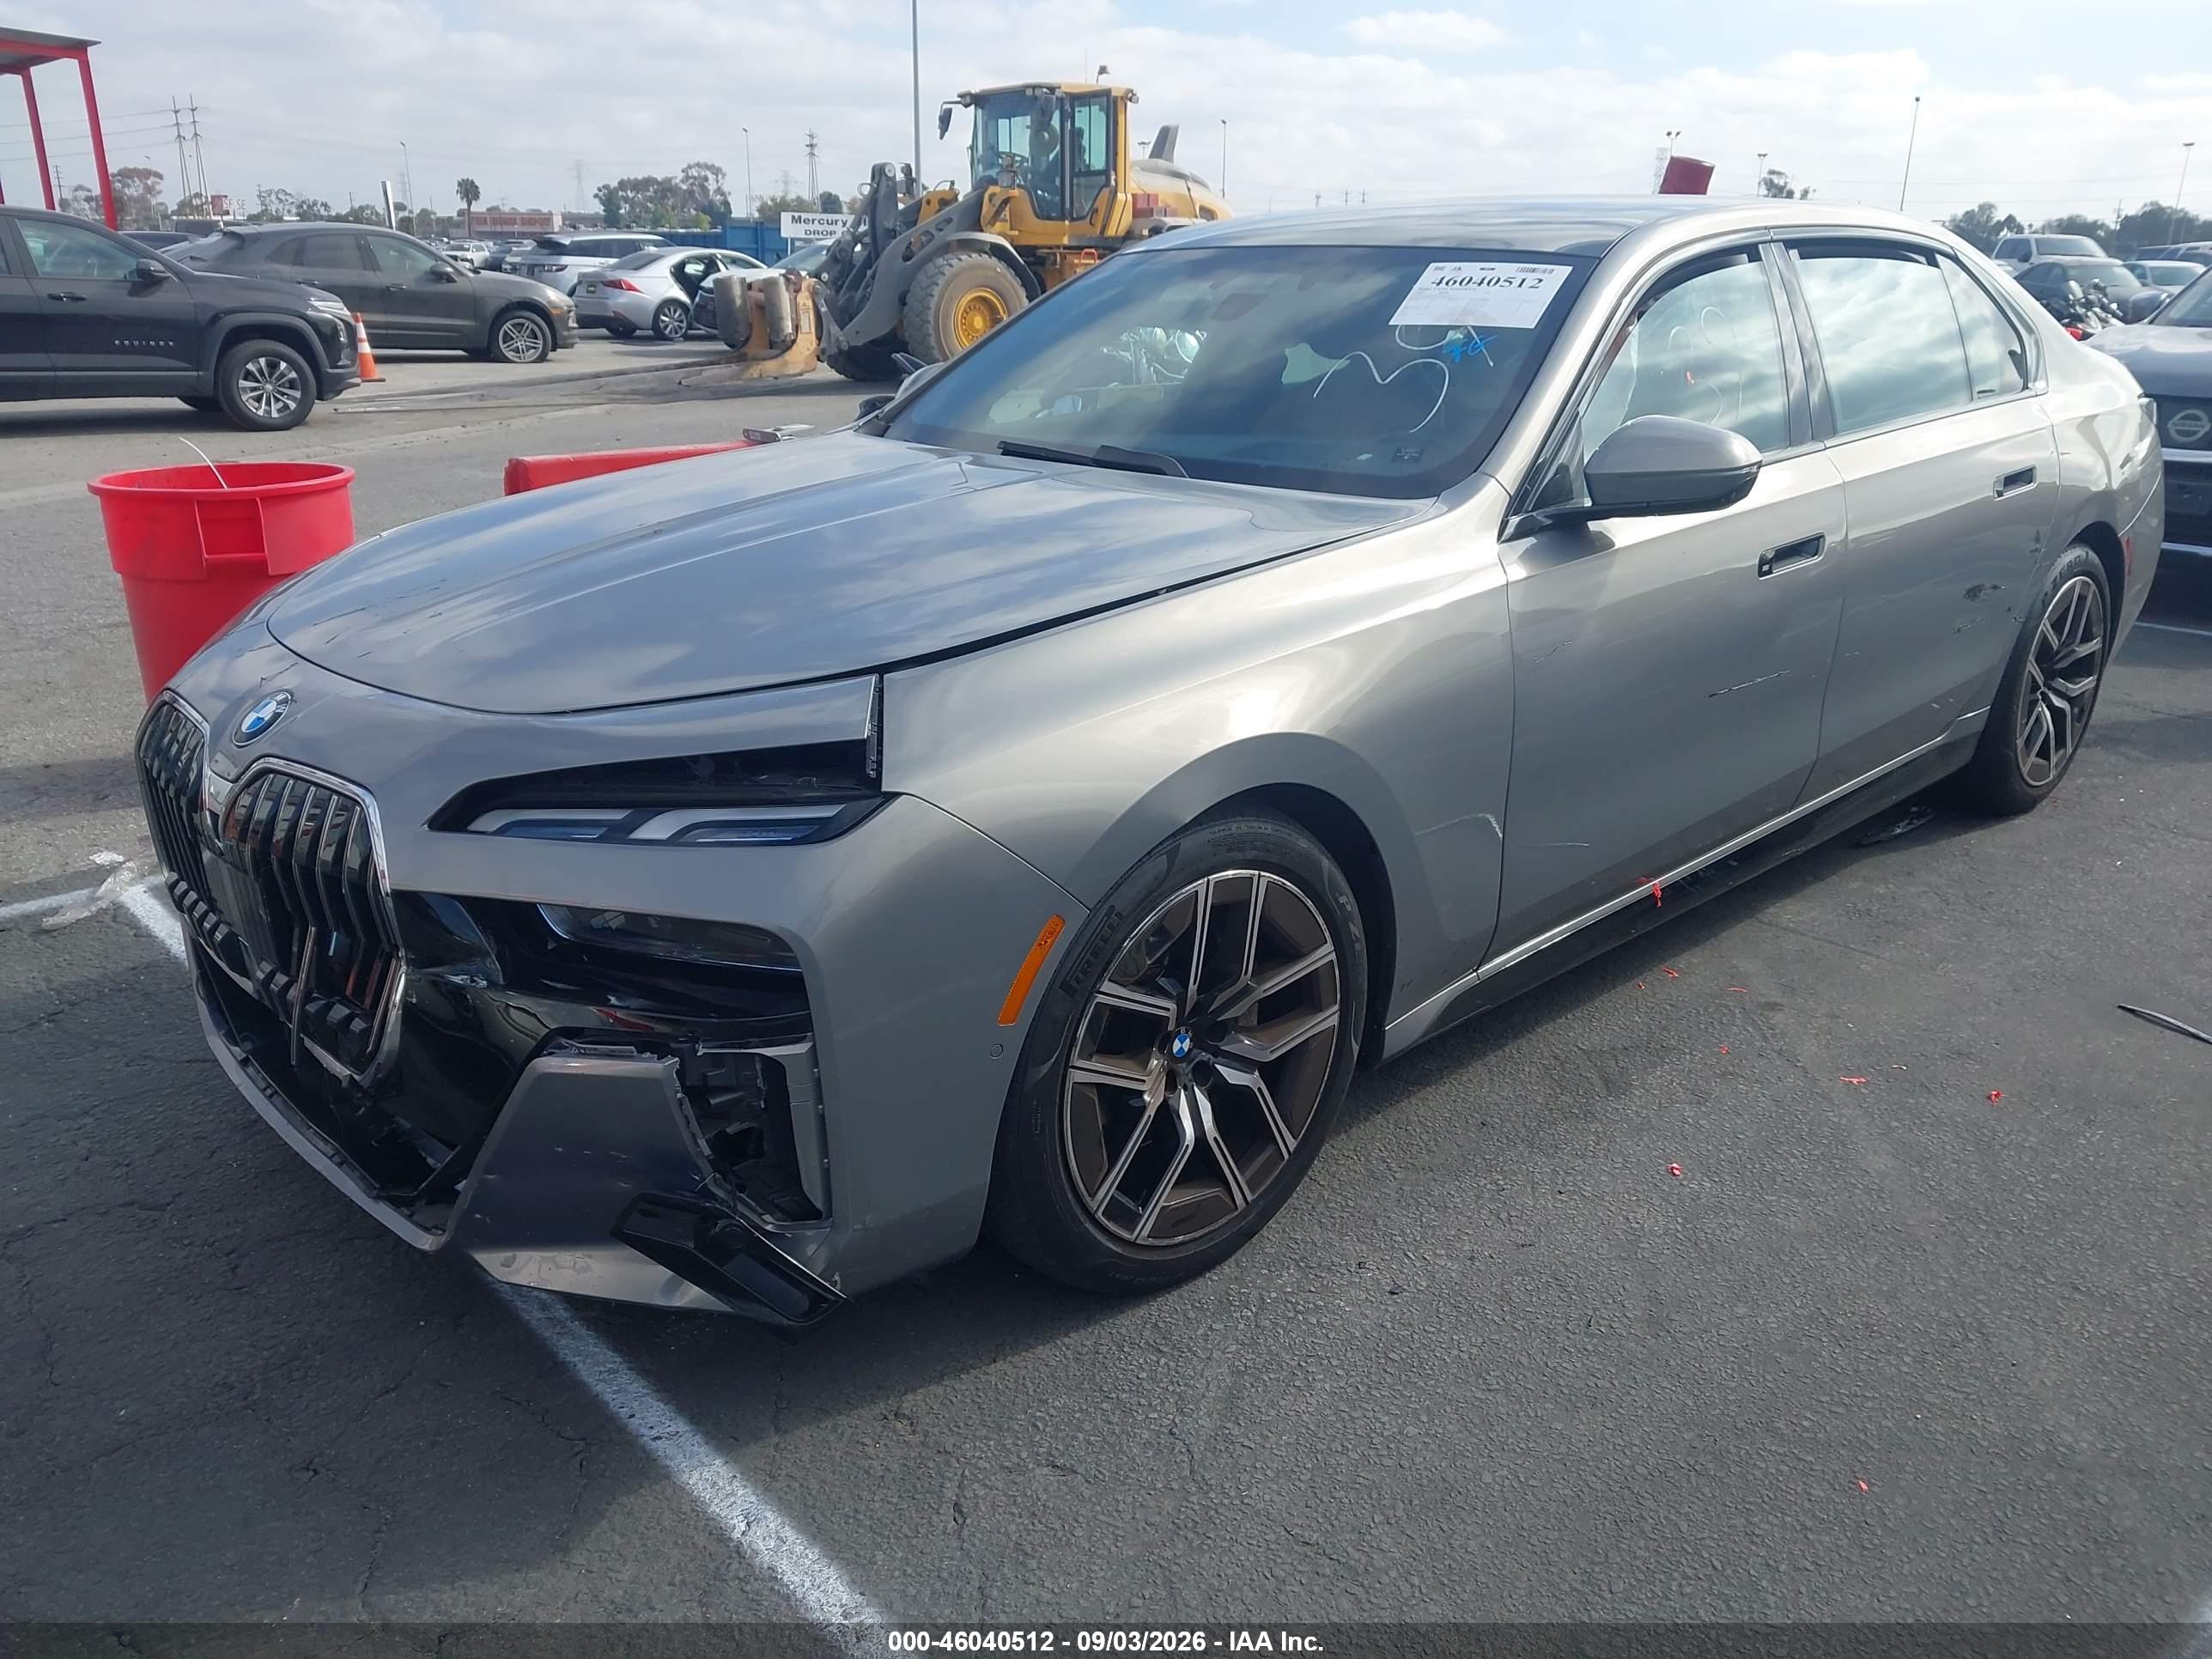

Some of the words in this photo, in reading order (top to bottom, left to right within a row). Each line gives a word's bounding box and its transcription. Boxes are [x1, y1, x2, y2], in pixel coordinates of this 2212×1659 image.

[791, 214, 848, 228] Mercury
[804, 228, 836, 237] DROP
[1431, 274, 1544, 289] 46040512
[1059, 904, 1125, 998] PIRELLI
